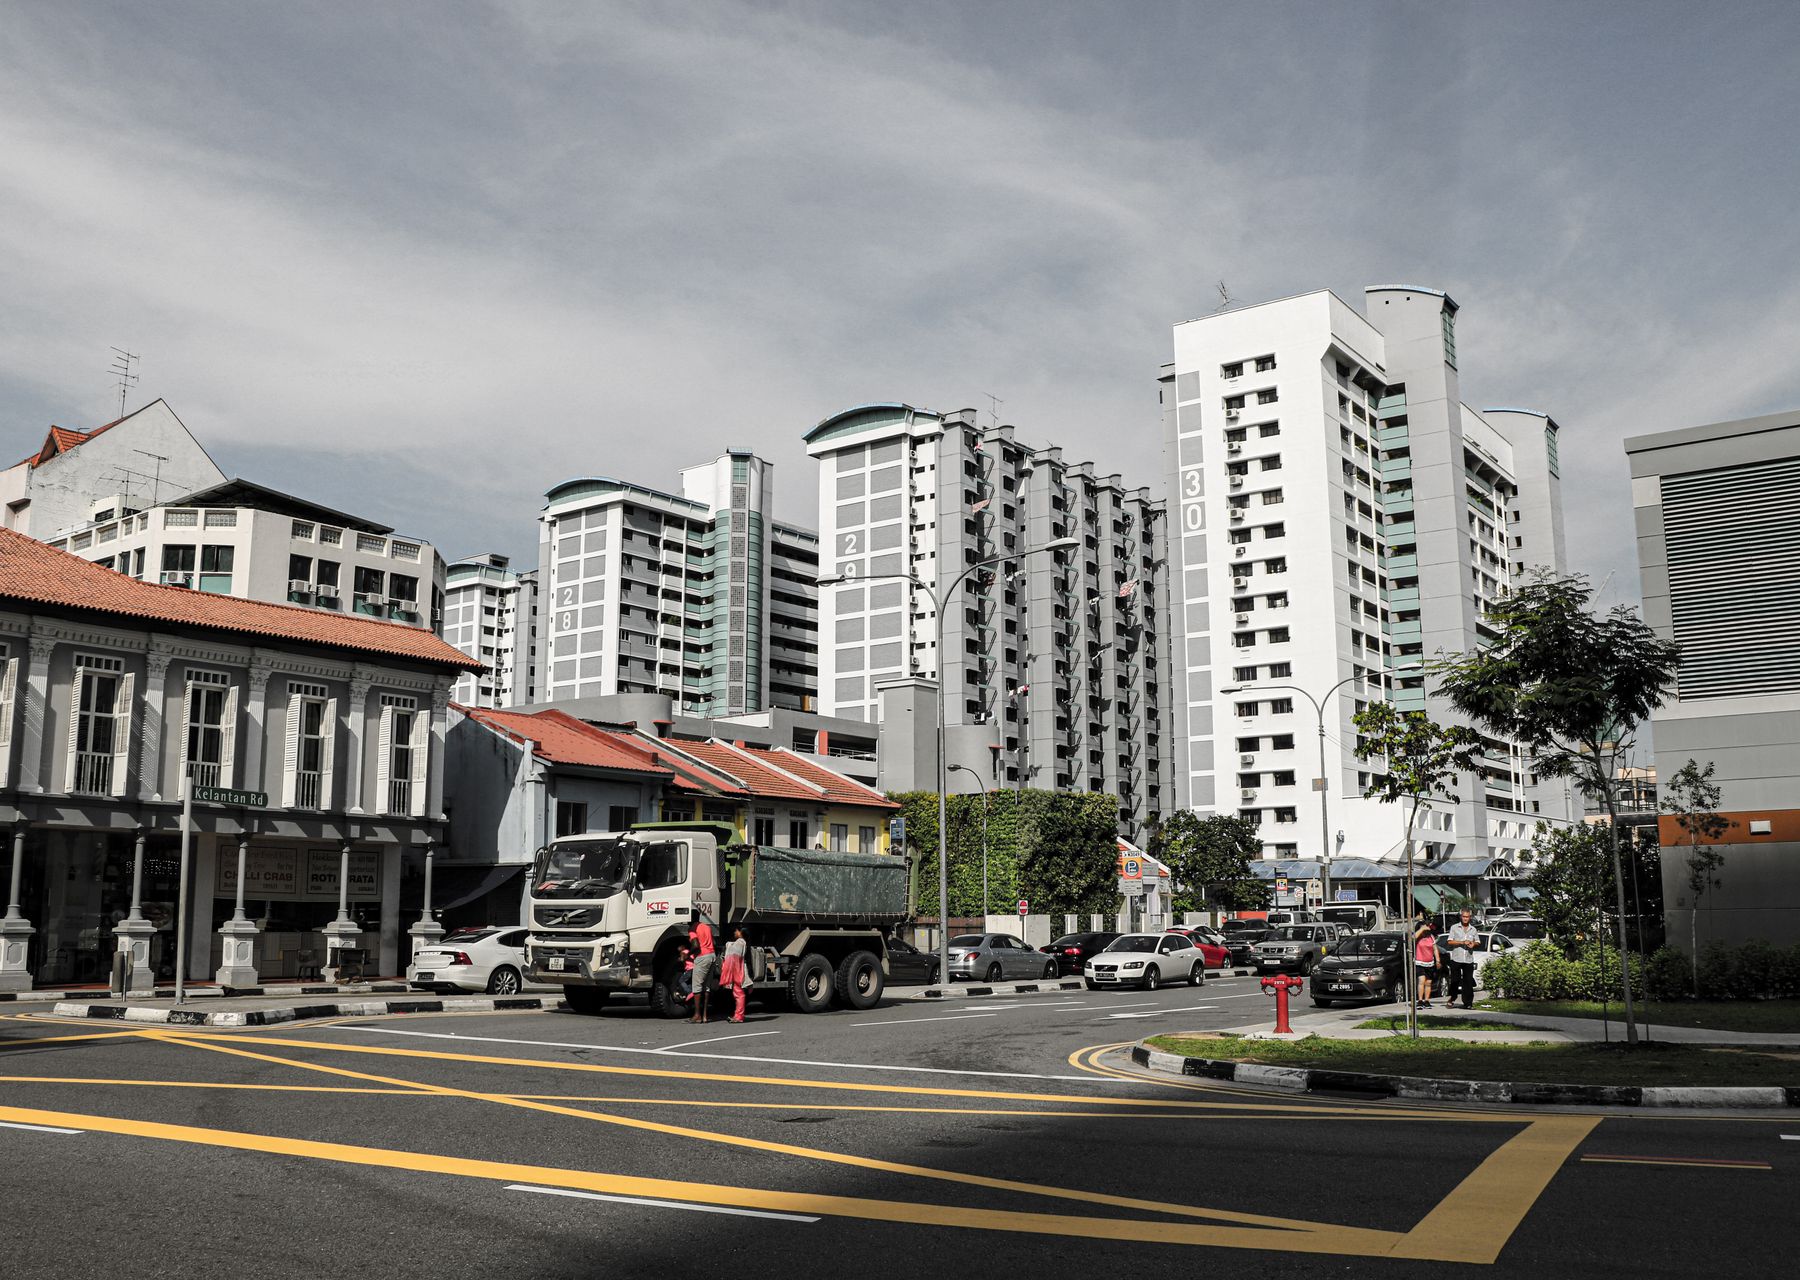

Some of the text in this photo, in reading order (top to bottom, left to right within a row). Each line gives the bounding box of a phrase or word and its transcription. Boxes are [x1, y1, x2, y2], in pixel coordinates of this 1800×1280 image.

[1185, 470, 1202, 530] 30
[562, 587, 573, 630] 28
[195, 787, 263, 805] Kelantan Rd
[224, 870, 293, 881] CHLLI CRAB
[311, 873, 374, 884] ROTI RATA
[696, 891, 703, 901] K
